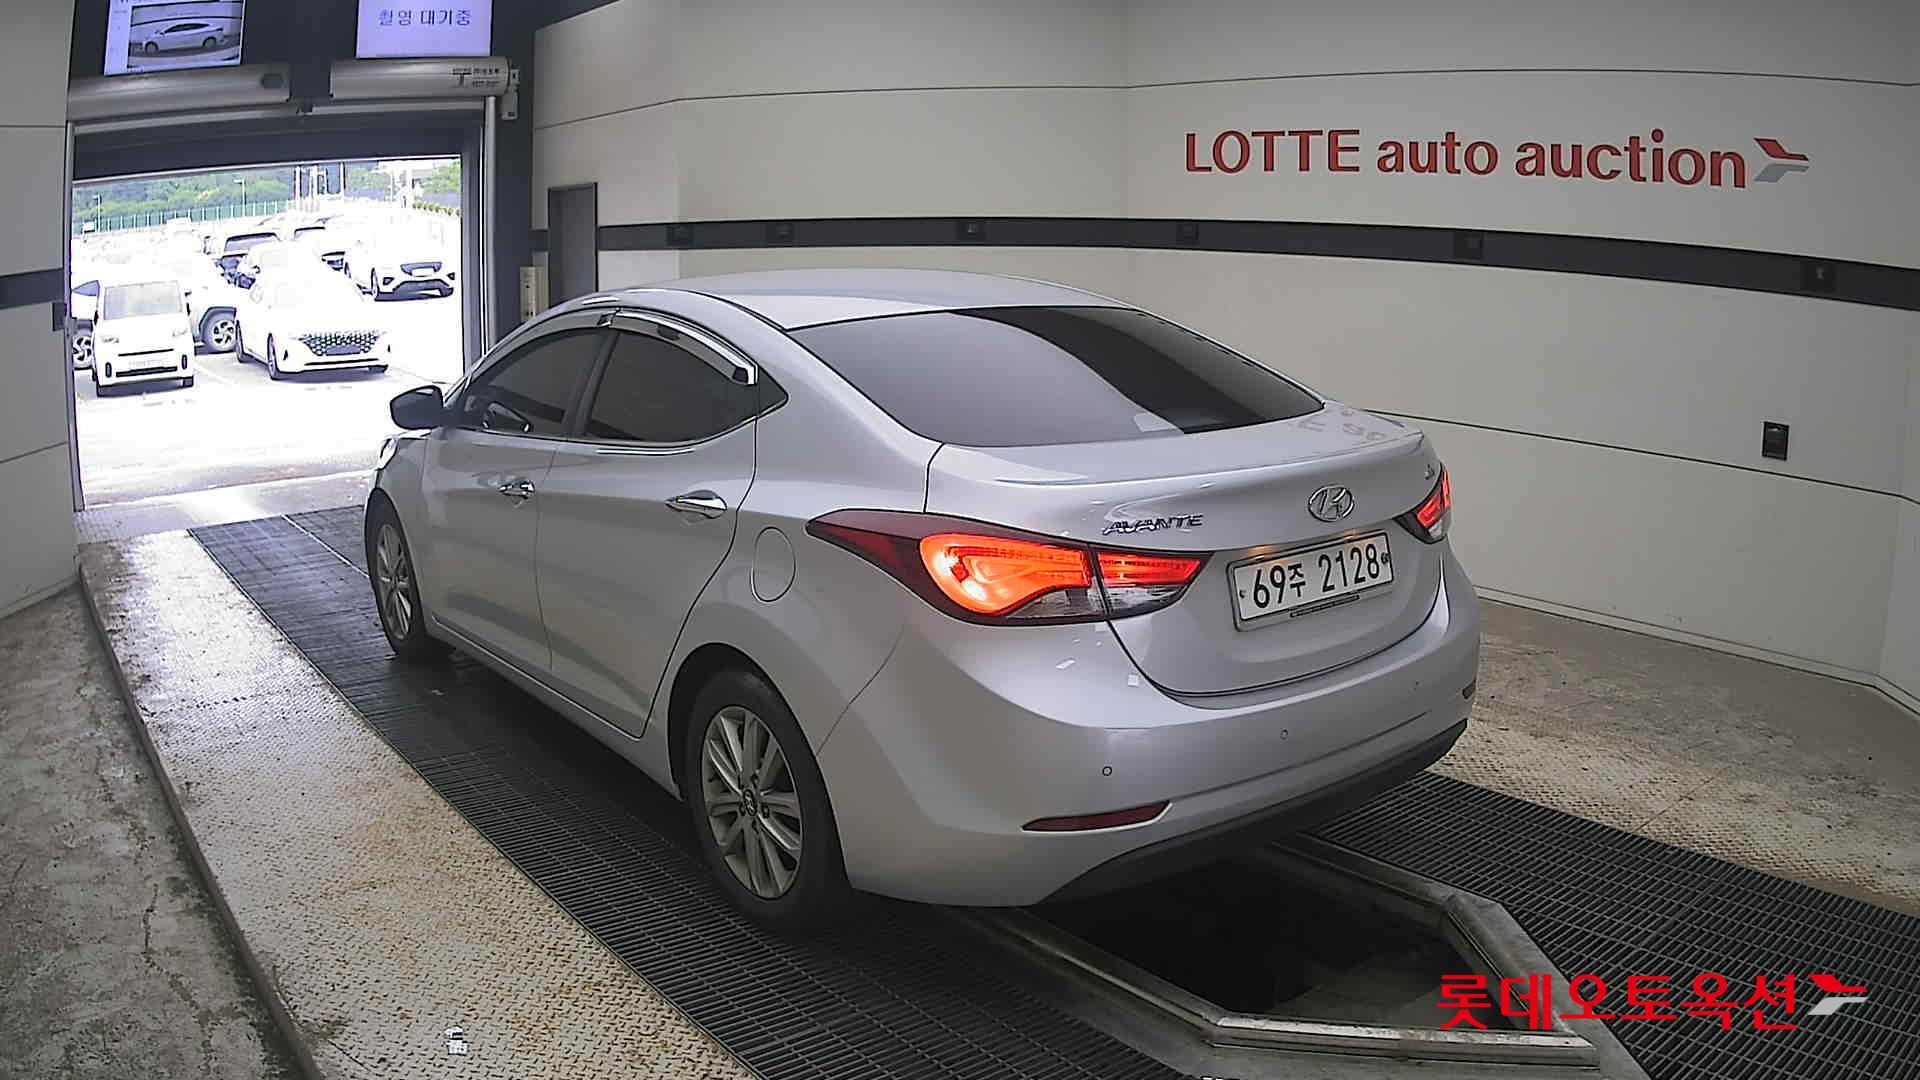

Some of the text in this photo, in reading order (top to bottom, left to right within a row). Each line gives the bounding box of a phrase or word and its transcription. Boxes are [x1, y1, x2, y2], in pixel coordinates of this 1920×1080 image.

[1186, 128, 1746, 188] LOTTE auto auction
[1102, 514, 1203, 535] AVANTE
[1253, 564, 1306, 608] 69주
[1318, 543, 1380, 592] 2128
